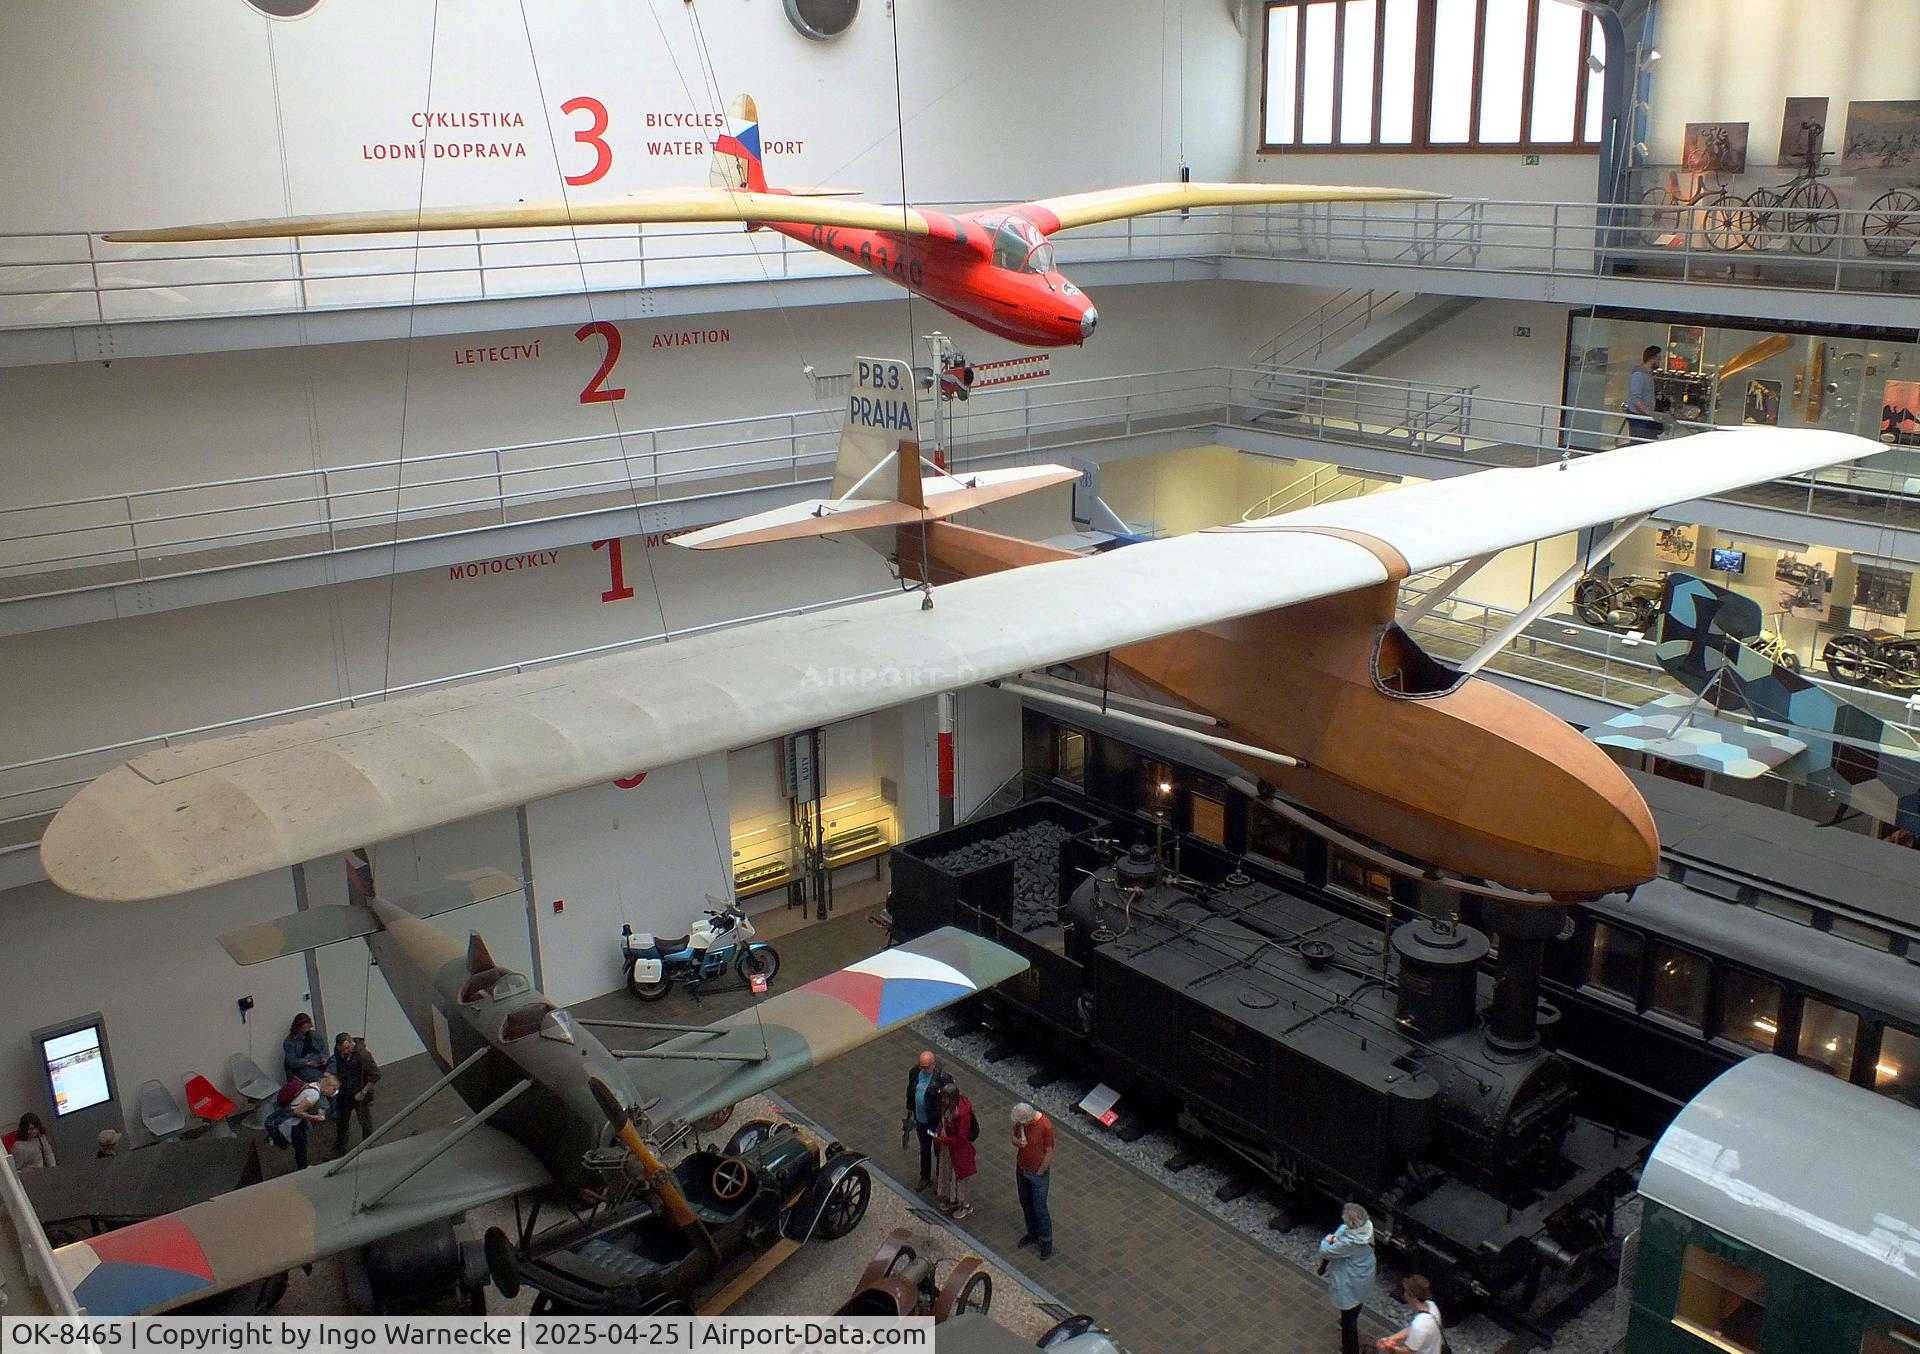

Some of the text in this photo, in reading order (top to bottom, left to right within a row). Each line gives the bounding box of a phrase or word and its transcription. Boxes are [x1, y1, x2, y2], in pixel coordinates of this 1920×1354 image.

[411, 112, 525, 128] CYKLISTIKA
[645, 113, 724, 128] BICYCLES
[362, 139, 527, 160] LODNÍ DOPRAVA
[560, 96, 613, 187] 3
[647, 141, 804, 156] WATER TPORT
[454, 339, 541, 365] LETECTVÍ
[652, 329, 731, 349] AVIATION
[574, 321, 628, 404] 2
[850, 395, 914, 431] PRAHA
[449, 550, 559, 580] MOTOCYKLY
[591, 537, 636, 603] 1
